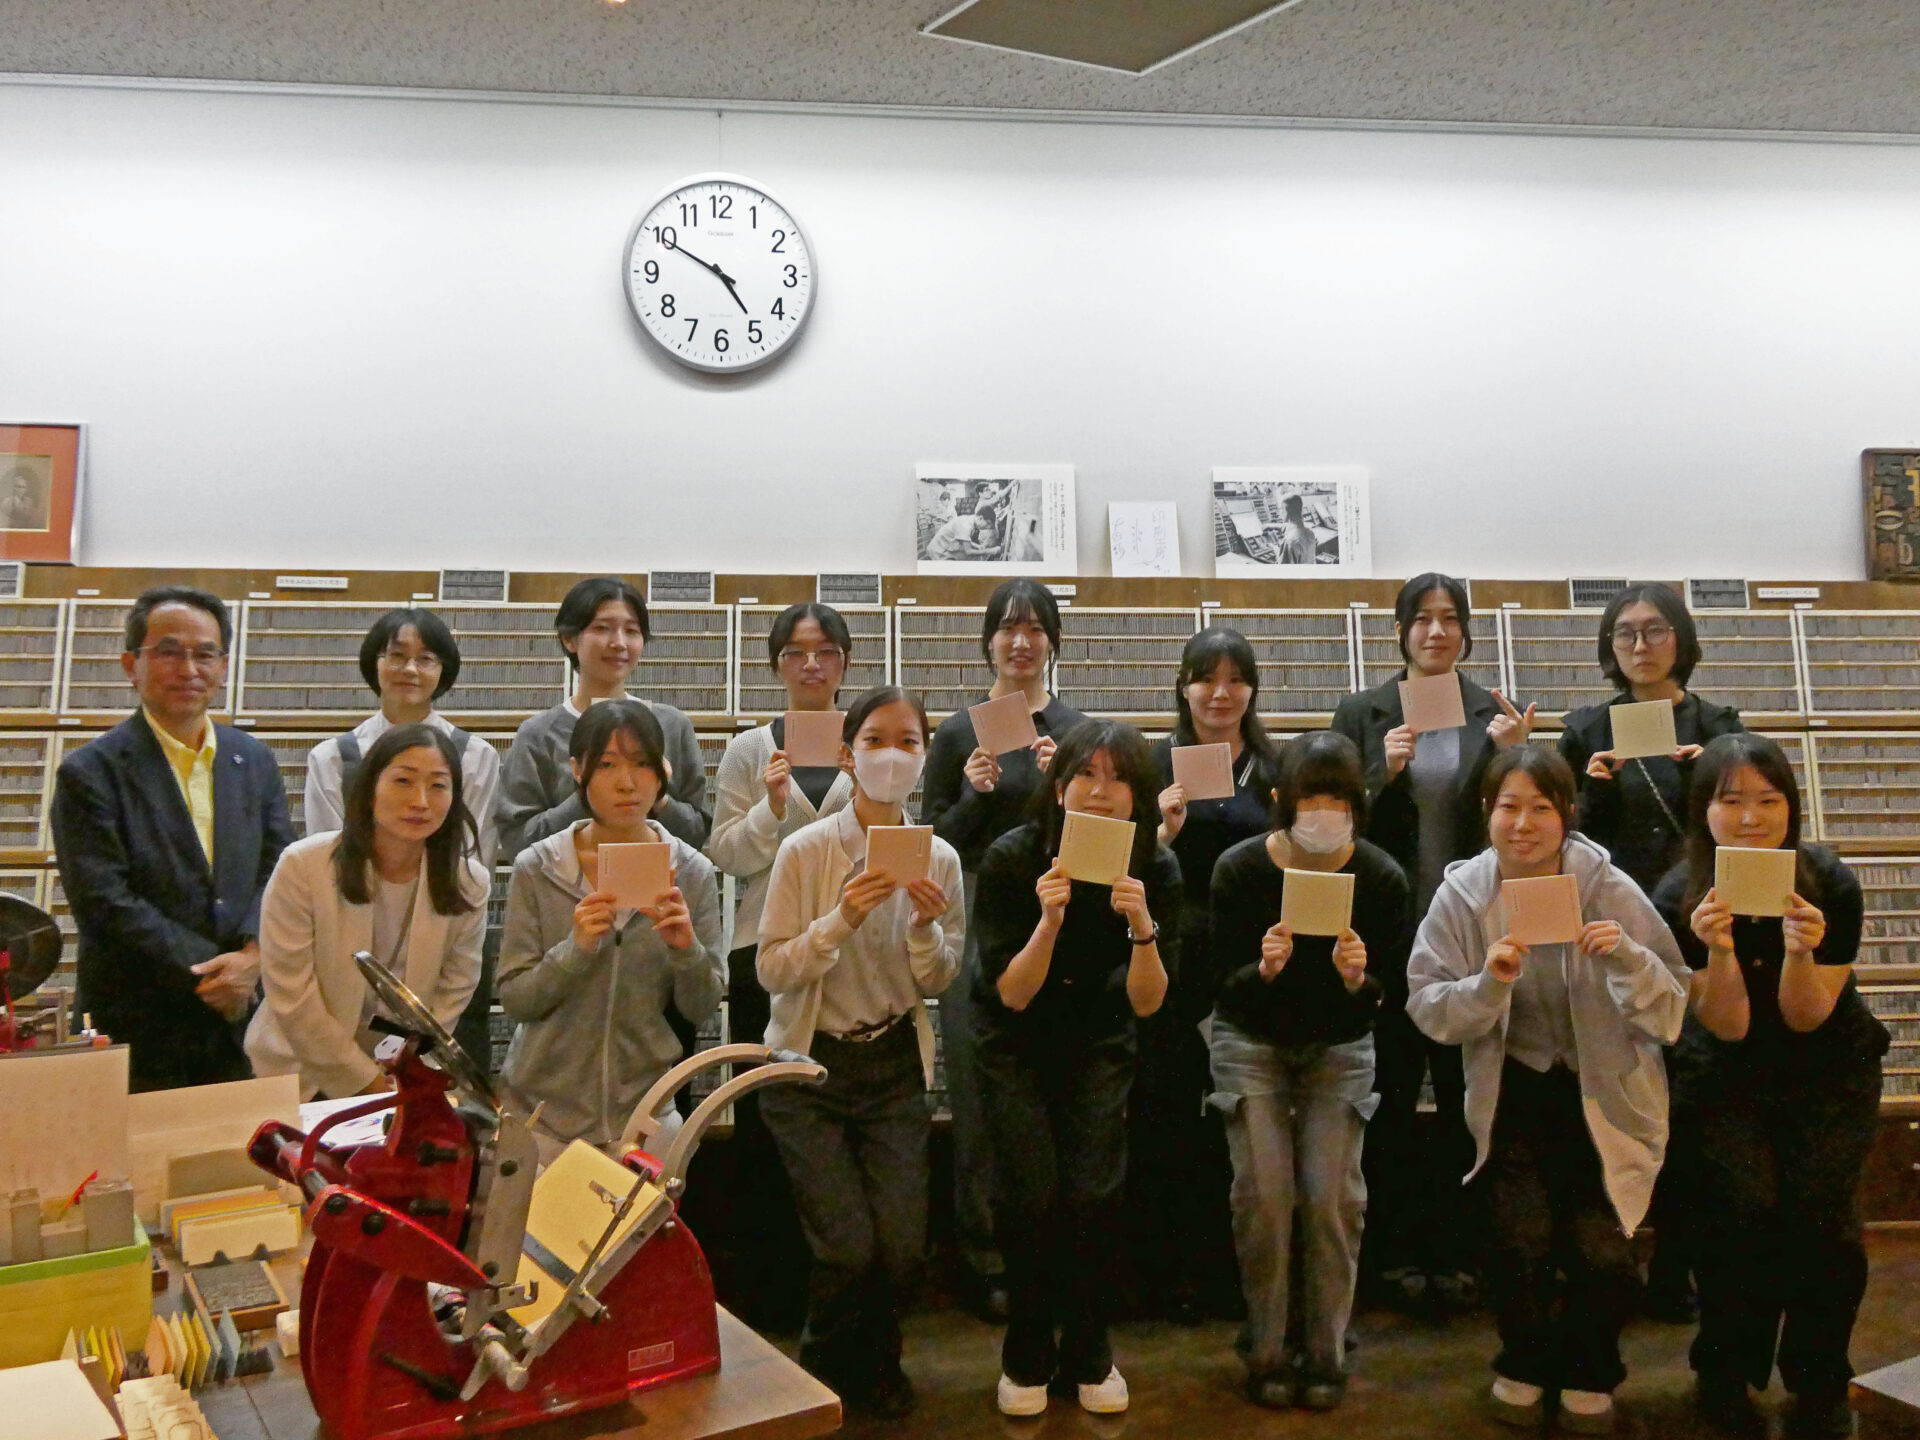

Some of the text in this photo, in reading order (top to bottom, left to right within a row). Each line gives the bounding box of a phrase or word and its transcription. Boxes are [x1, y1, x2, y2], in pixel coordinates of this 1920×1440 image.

[679, 203, 697, 227] 11
[709, 195, 733, 219] 12
[749, 206, 757, 229] 1
[652, 226, 677, 250] 10
[771, 230, 786, 253] 2
[644, 260, 660, 284] 9
[783, 264, 798, 288] 3
[661, 294, 676, 317] 8
[771, 297, 785, 320] 4
[684, 319, 699, 342] 7
[714, 329, 729, 352] 6
[748, 320, 762, 343] 5
